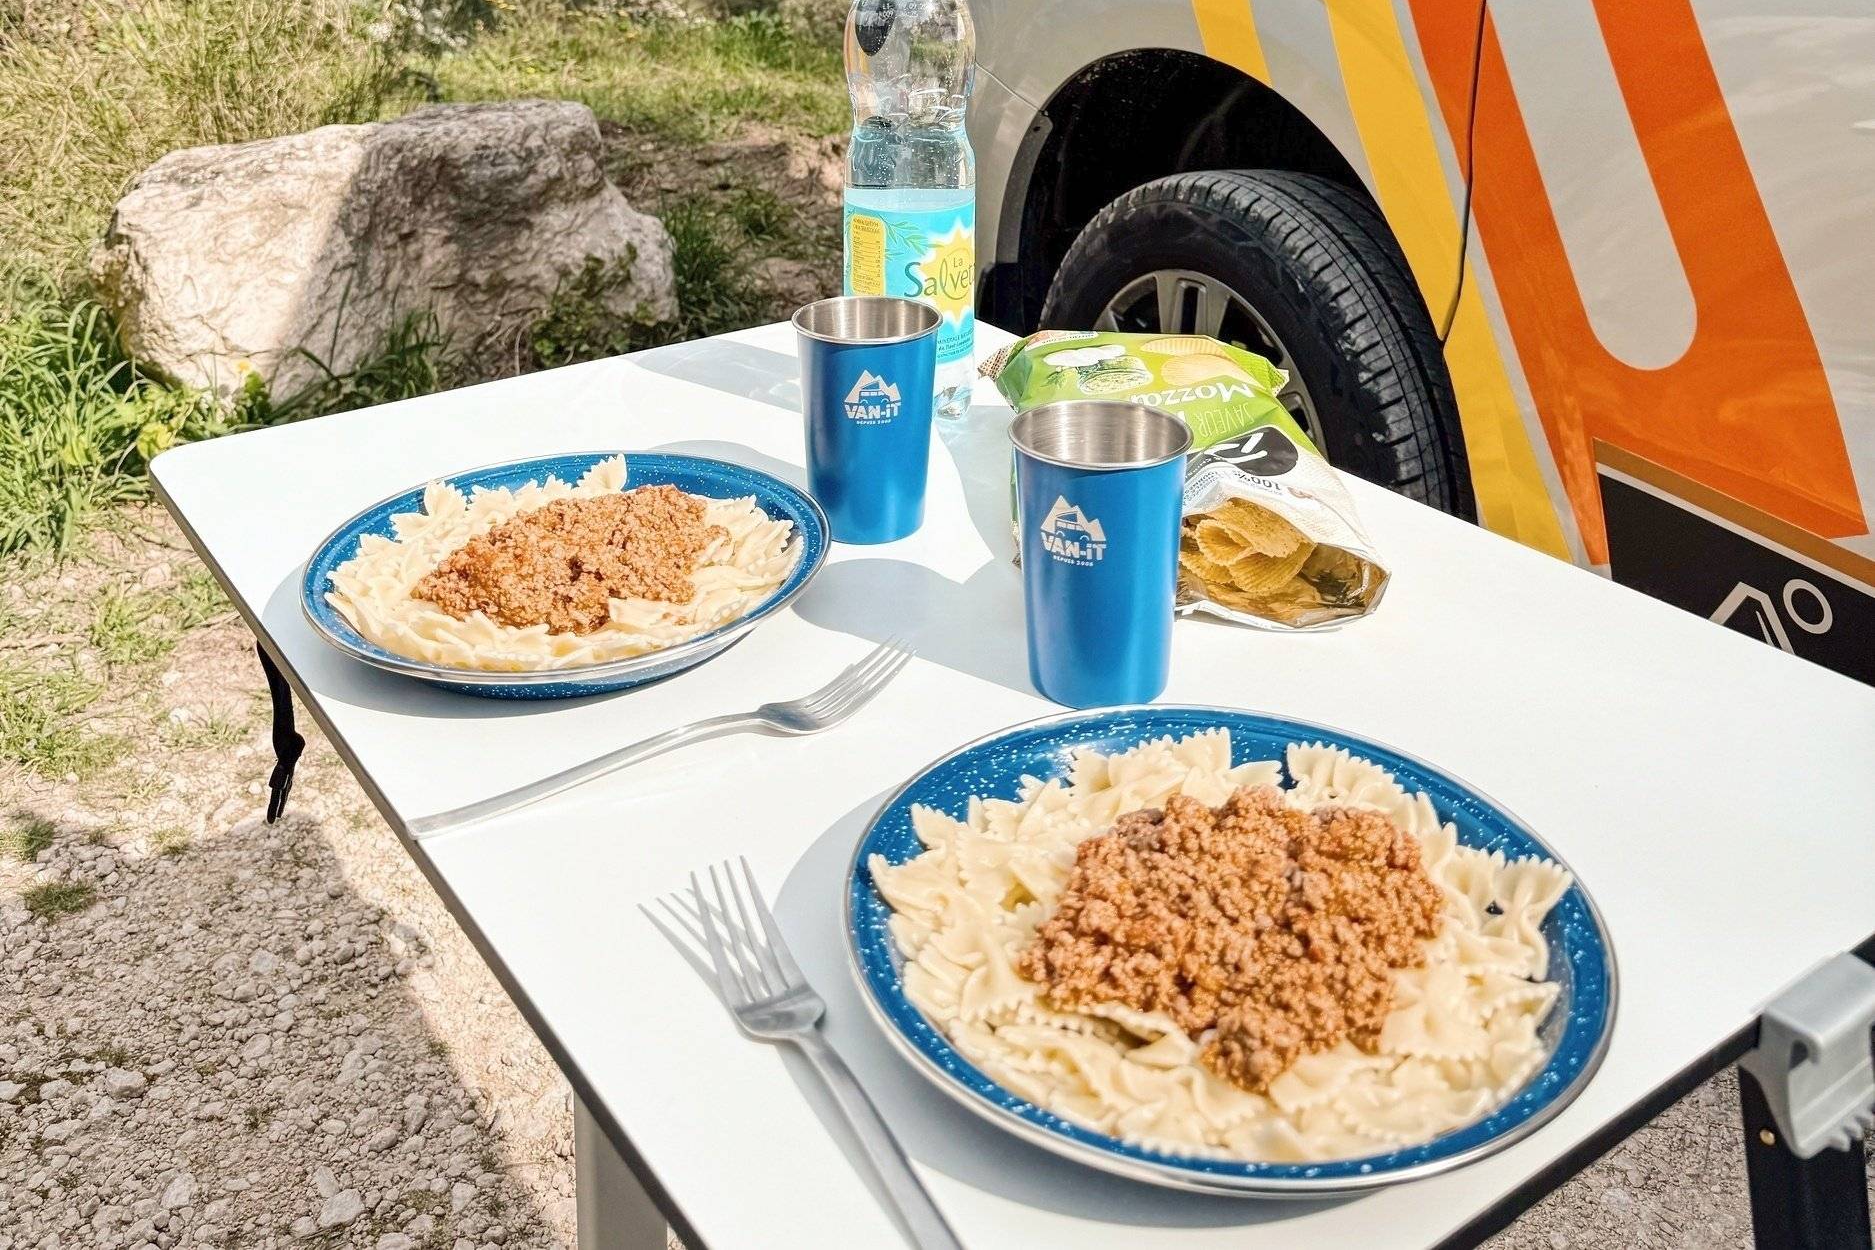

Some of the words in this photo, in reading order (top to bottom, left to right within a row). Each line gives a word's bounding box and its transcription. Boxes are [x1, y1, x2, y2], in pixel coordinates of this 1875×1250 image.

[953, 257, 964, 268] La
[1196, 402, 1255, 438] SAVEUR
[1232, 470, 1282, 492] 100%
